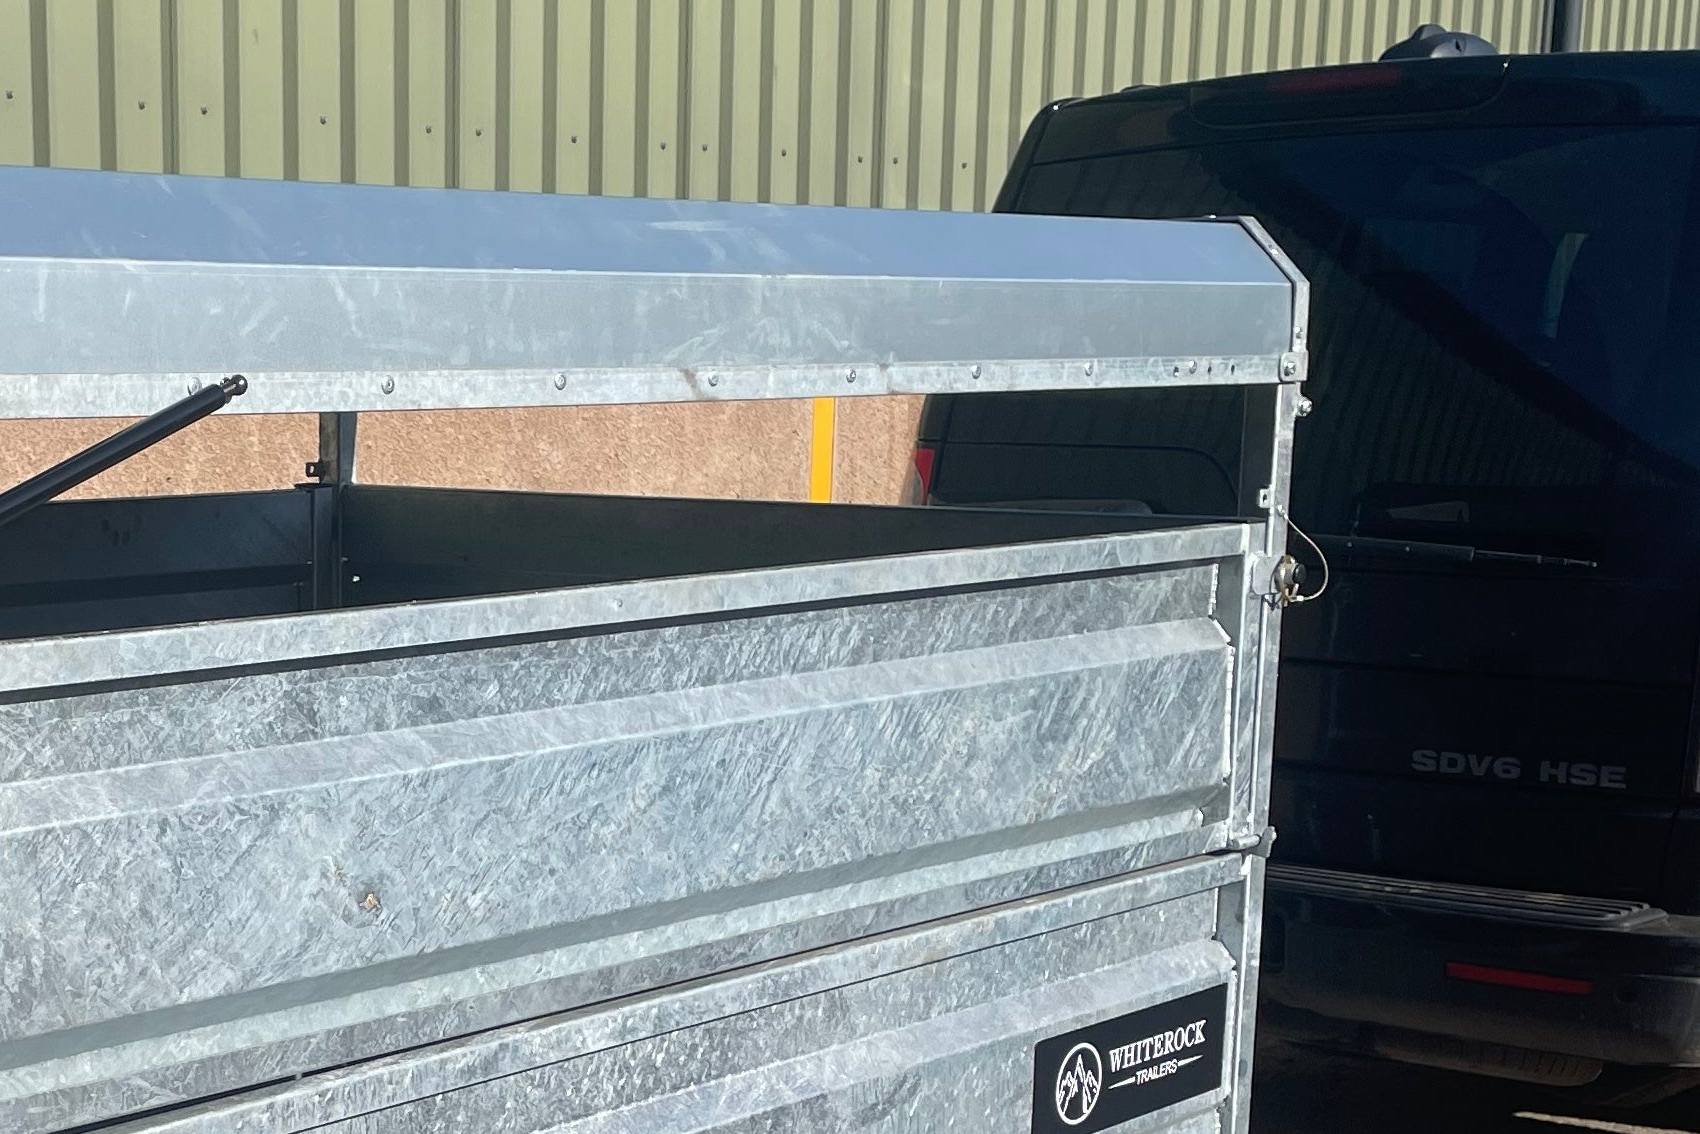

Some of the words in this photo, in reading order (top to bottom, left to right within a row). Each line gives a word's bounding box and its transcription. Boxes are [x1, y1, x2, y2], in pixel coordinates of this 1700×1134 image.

[1411, 749, 1521, 780] SDV6
[1539, 760, 1628, 789] HSE
[1108, 1019, 1207, 1073] WHITEROCK
[1135, 1058, 1179, 1085] TRAILERS
